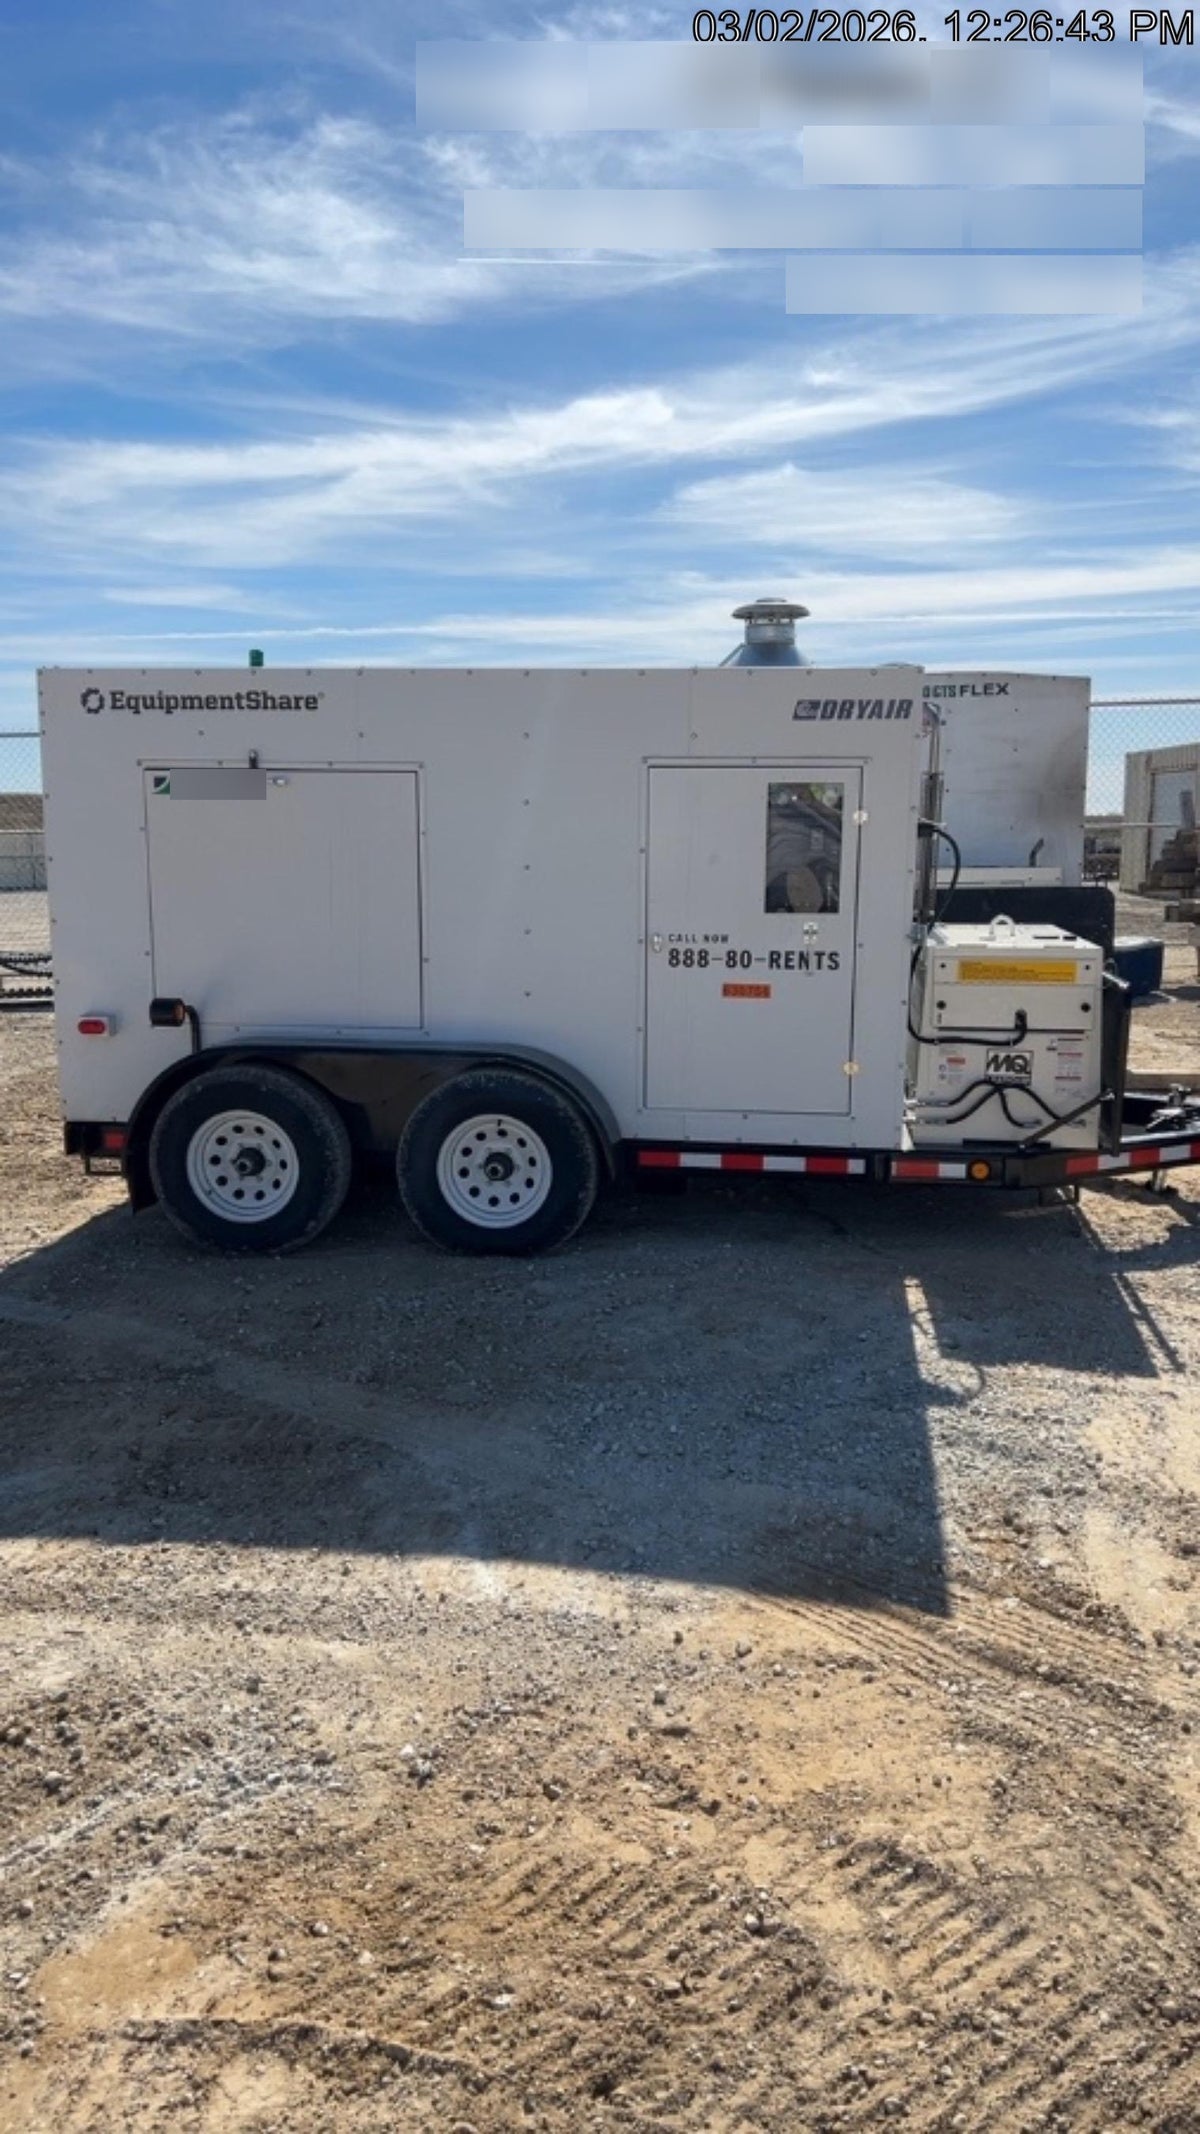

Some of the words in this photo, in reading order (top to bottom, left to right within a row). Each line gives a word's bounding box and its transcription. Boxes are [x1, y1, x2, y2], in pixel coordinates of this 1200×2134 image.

[959, 682, 1010, 698] FLEX
[109, 689, 319, 715] EquipmentShare
[819, 698, 914, 721] DRYAIR
[668, 933, 697, 944] CALL
[703, 934, 730, 944] NOW
[668, 948, 840, 971] 888-80-RENTS
[986, 1053, 1032, 1074] MQ
